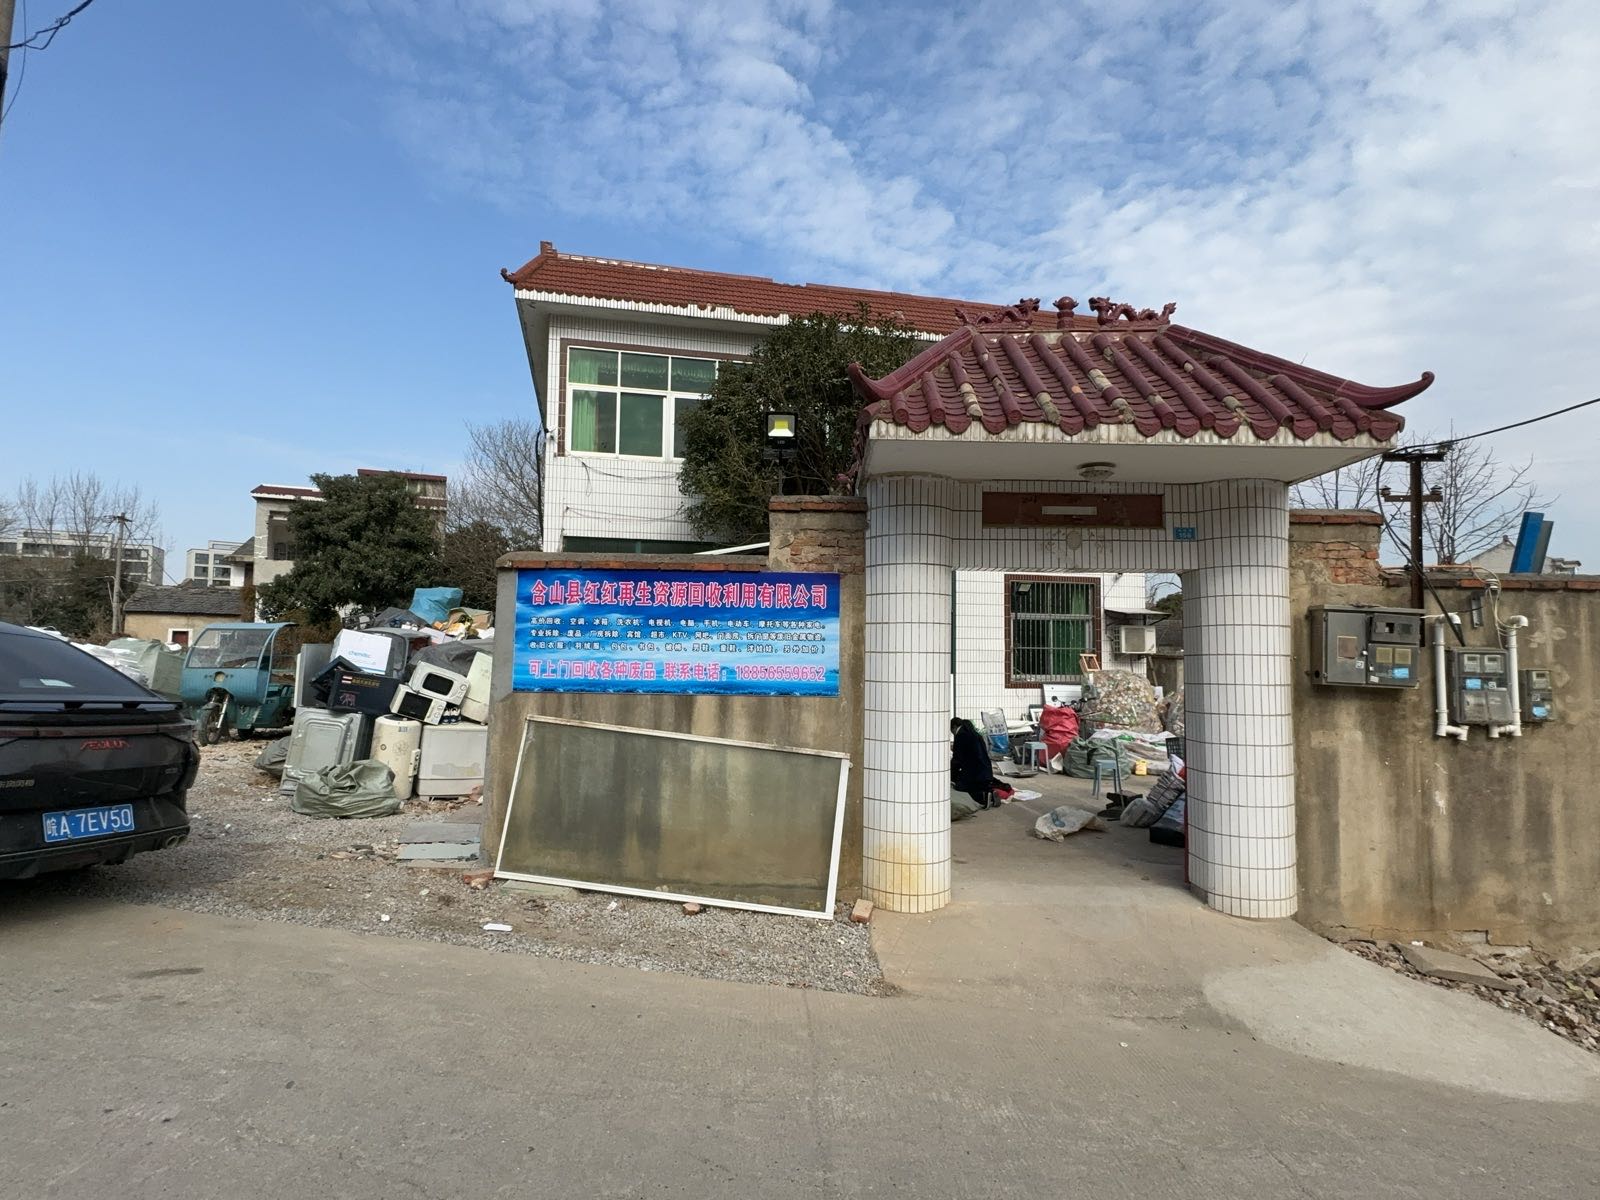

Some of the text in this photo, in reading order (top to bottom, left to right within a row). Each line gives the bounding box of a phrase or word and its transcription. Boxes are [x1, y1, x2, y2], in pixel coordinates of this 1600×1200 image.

[531, 580, 827, 608] 含山县红红再生资源回收利用有限公司
[529, 659, 656, 680] 可上门回收各种废品
